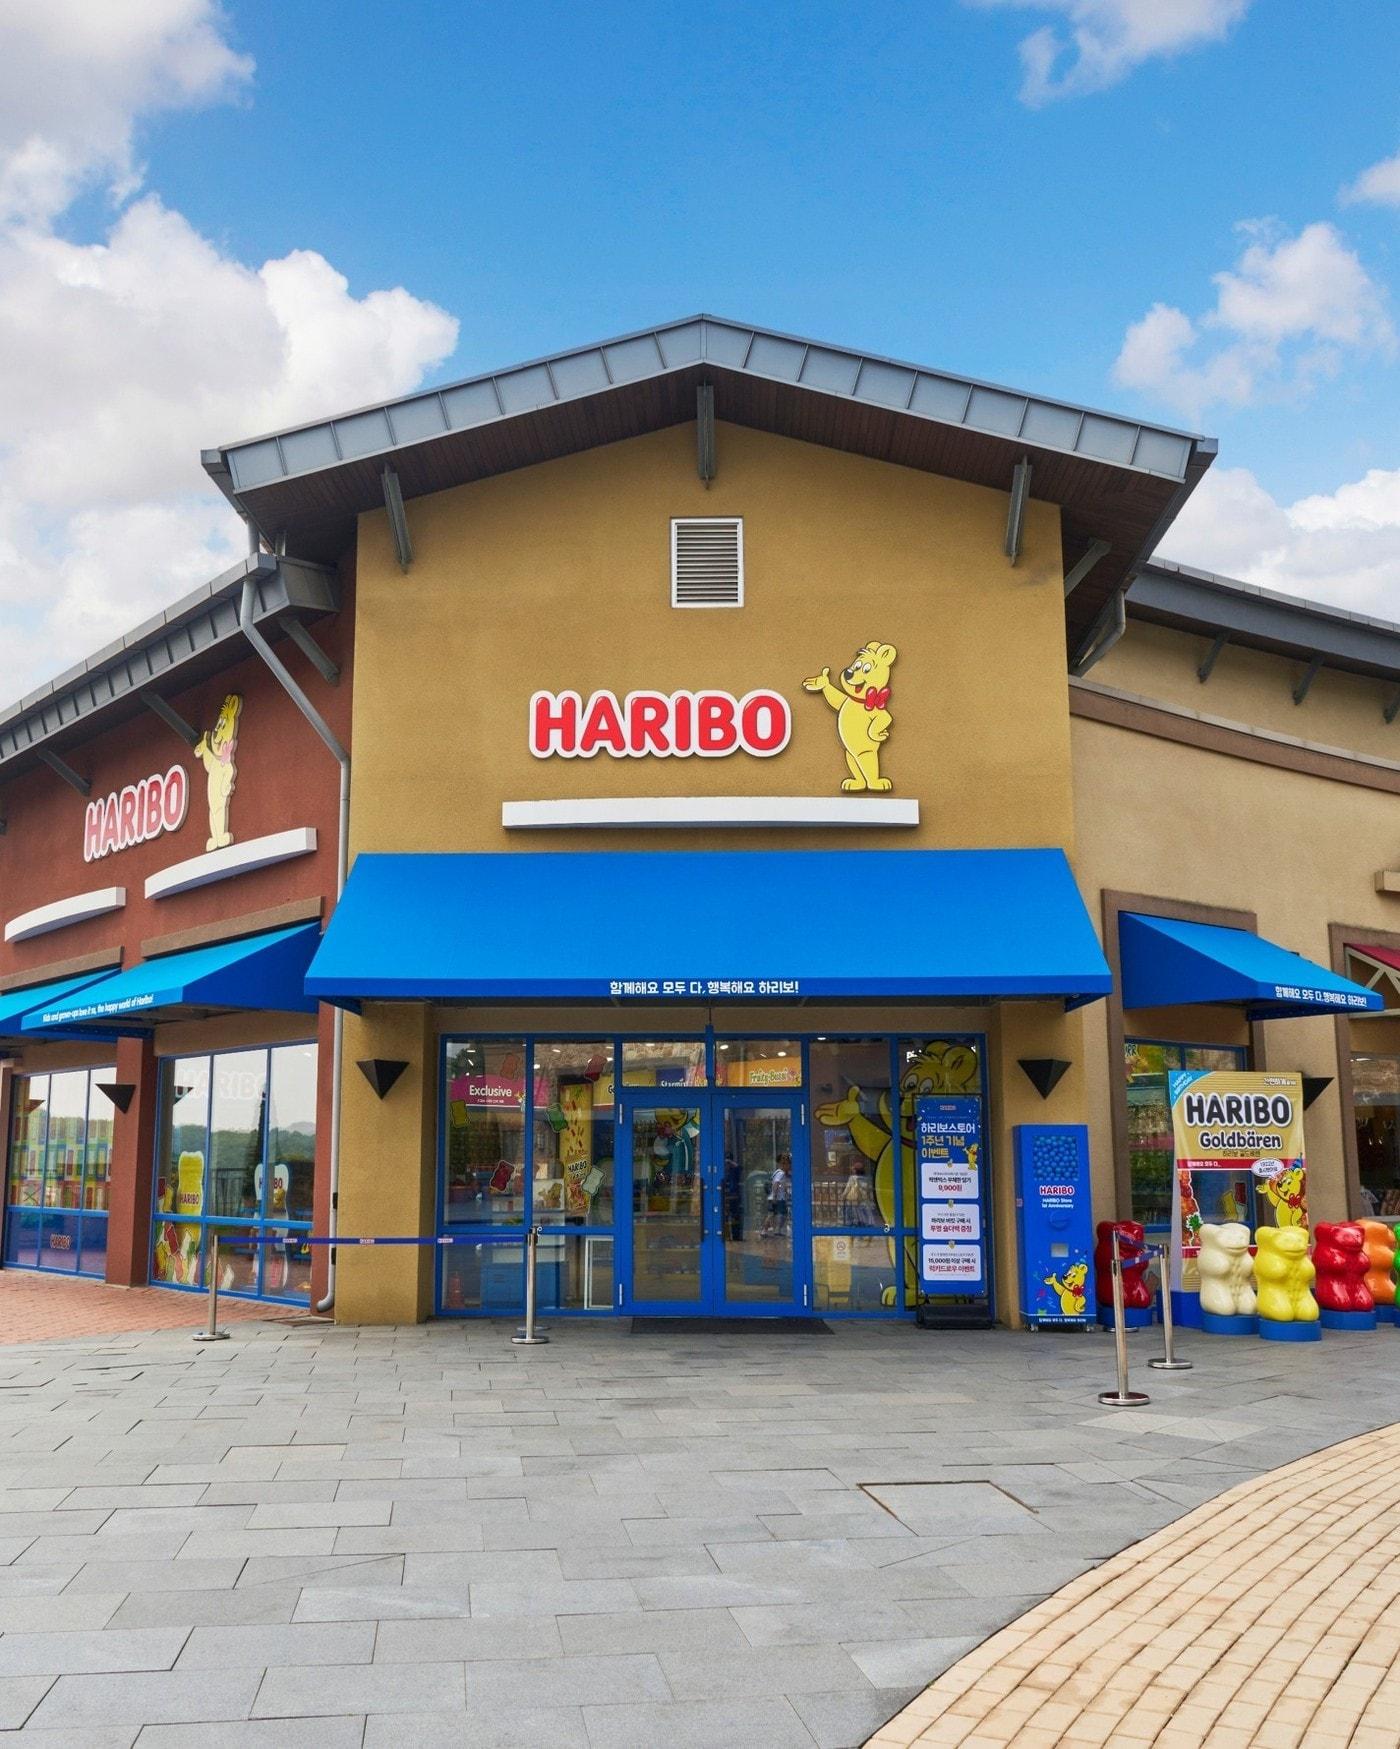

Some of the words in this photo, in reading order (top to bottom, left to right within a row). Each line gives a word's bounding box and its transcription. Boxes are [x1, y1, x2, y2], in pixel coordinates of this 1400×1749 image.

[531, 691, 790, 756] HARIBO
[84, 766, 185, 862] HARIBO
[609, 981, 659, 995] 함께해요
[662, 981, 686, 994] 모두
[758, 981, 799, 994] 하리보!
[1275, 986, 1301, 999] 함께해요
[1302, 989, 1315, 1001] 모두
[469, 1085, 512, 1097] Exclusive
[1185, 1094, 1291, 1126] HARIBO
[921, 1122, 976, 1133] 하리보스토어
[921, 1135, 944, 1146] 1주년
[946, 1135, 965, 1147] 기념
[1199, 1131, 1281, 1148] Goldbären
[921, 1147, 949, 1158] 이벤트
[1039, 1185, 1075, 1195] HARIBO
